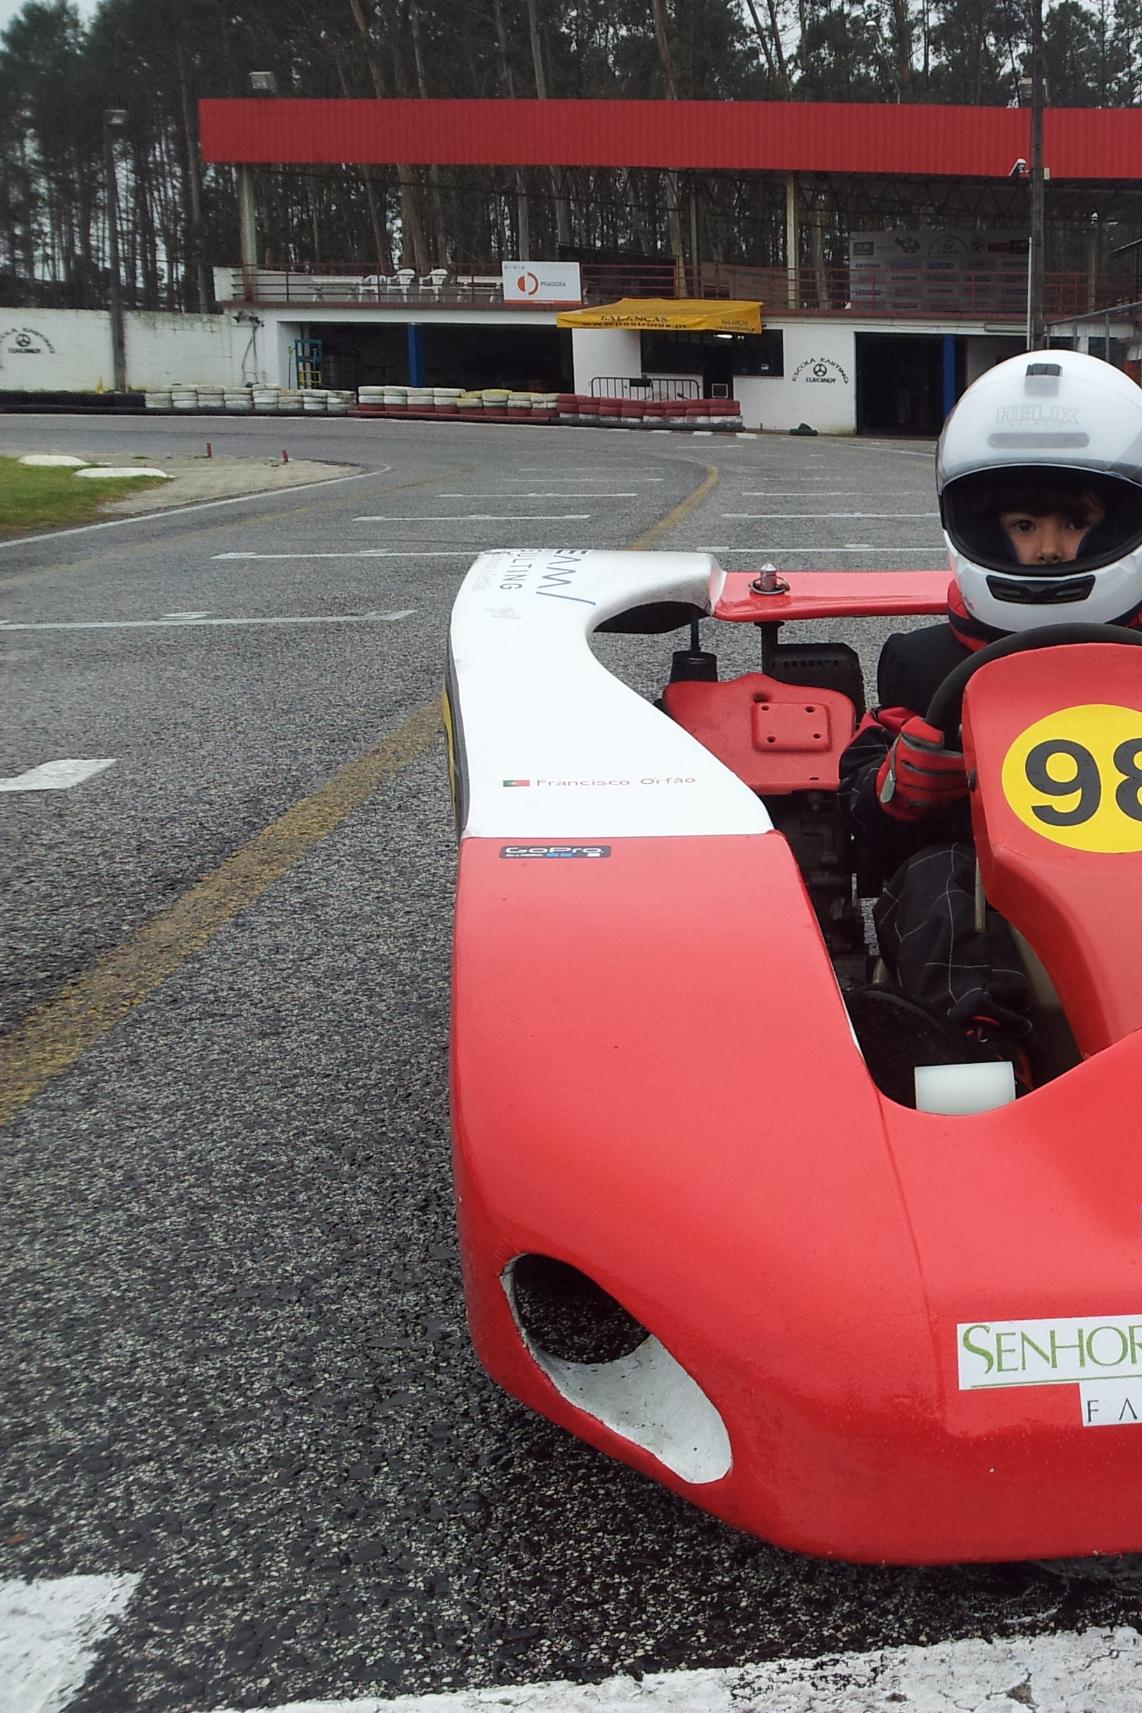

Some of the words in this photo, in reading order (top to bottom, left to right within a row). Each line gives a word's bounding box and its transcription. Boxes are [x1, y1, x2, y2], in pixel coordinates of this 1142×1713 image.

[791, 357, 816, 382] ESCOLA
[820, 357, 849, 384] KARTING
[995, 405, 1081, 424] HELIX
[536, 779, 630, 787] Francisco
